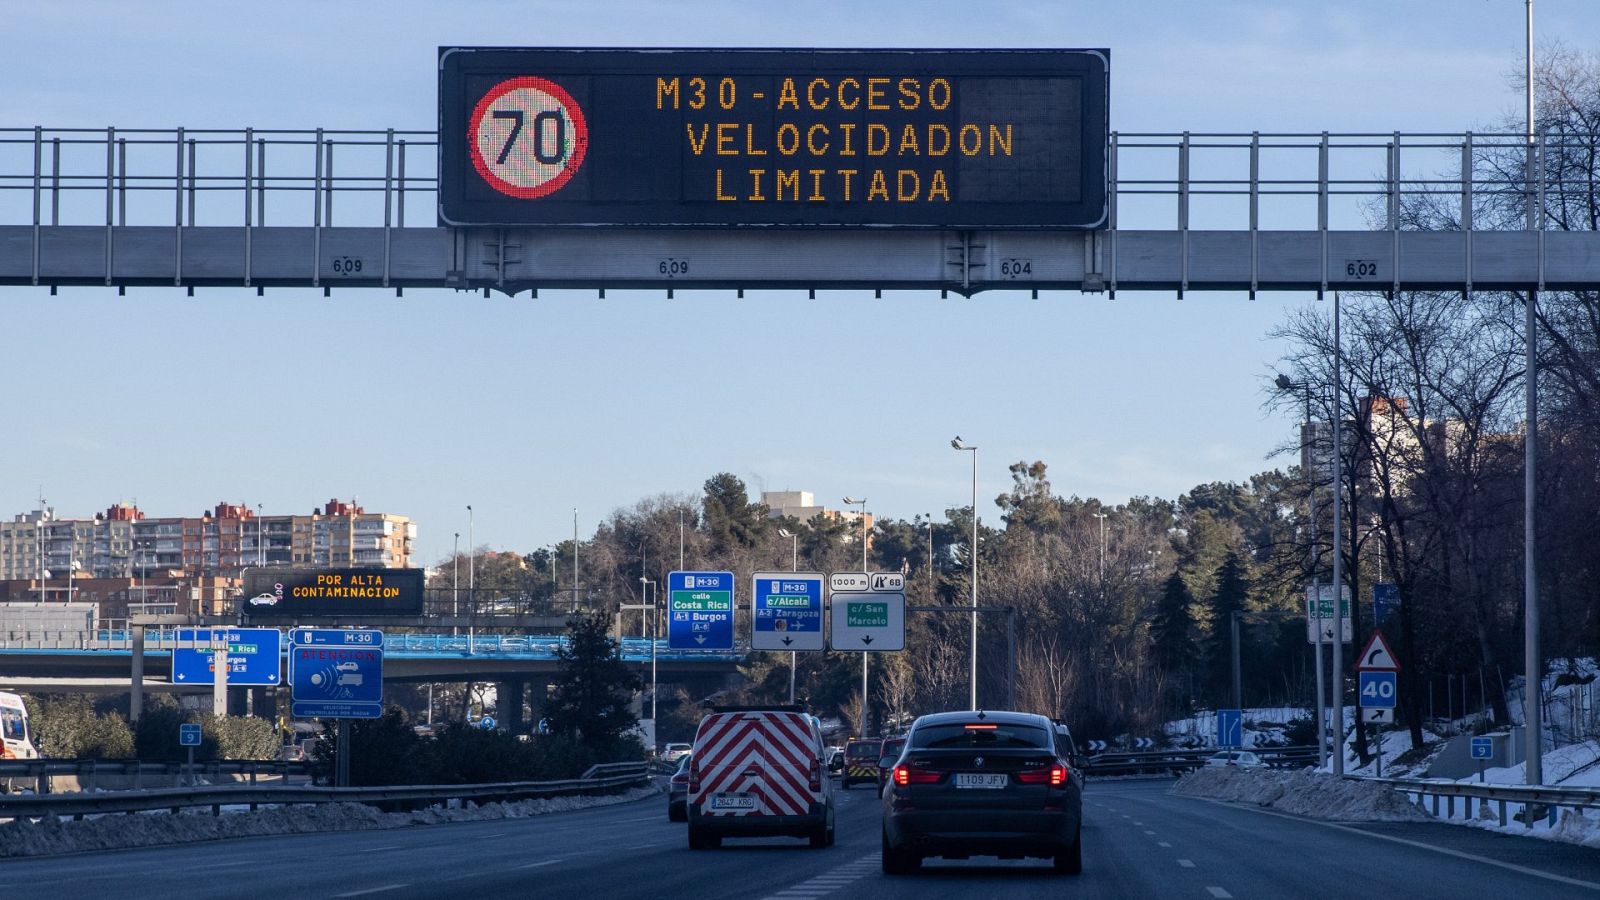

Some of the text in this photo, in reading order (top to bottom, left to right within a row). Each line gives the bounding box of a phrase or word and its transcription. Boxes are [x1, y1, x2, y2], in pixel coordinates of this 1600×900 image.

[493, 110, 566, 165] 70
[686, 123, 1013, 156] VELOCIDADON
[716, 169, 951, 201] LIMITADA
[317, 574, 383, 586] POR ALTA
[889, 579, 901, 587] 6B
[293, 587, 400, 598] CONTAMINACION
[784, 584, 806, 592] M-30
[691, 592, 711, 600] calle
[673, 600, 729, 609] Costa Rica
[865, 604, 884, 613] San
[692, 612, 727, 623] Burgos
[759, 609, 819, 620] A-2 Zaragoza
[848, 616, 887, 625] Marcelo
[346, 634, 371, 642] M-30
[238, 645, 257, 653] Rica
[1362, 681, 1393, 698] 40
[187, 733, 194, 743] 9
[1478, 747, 1485, 756] 9
[960, 775, 1006, 785] 1109 JFV
